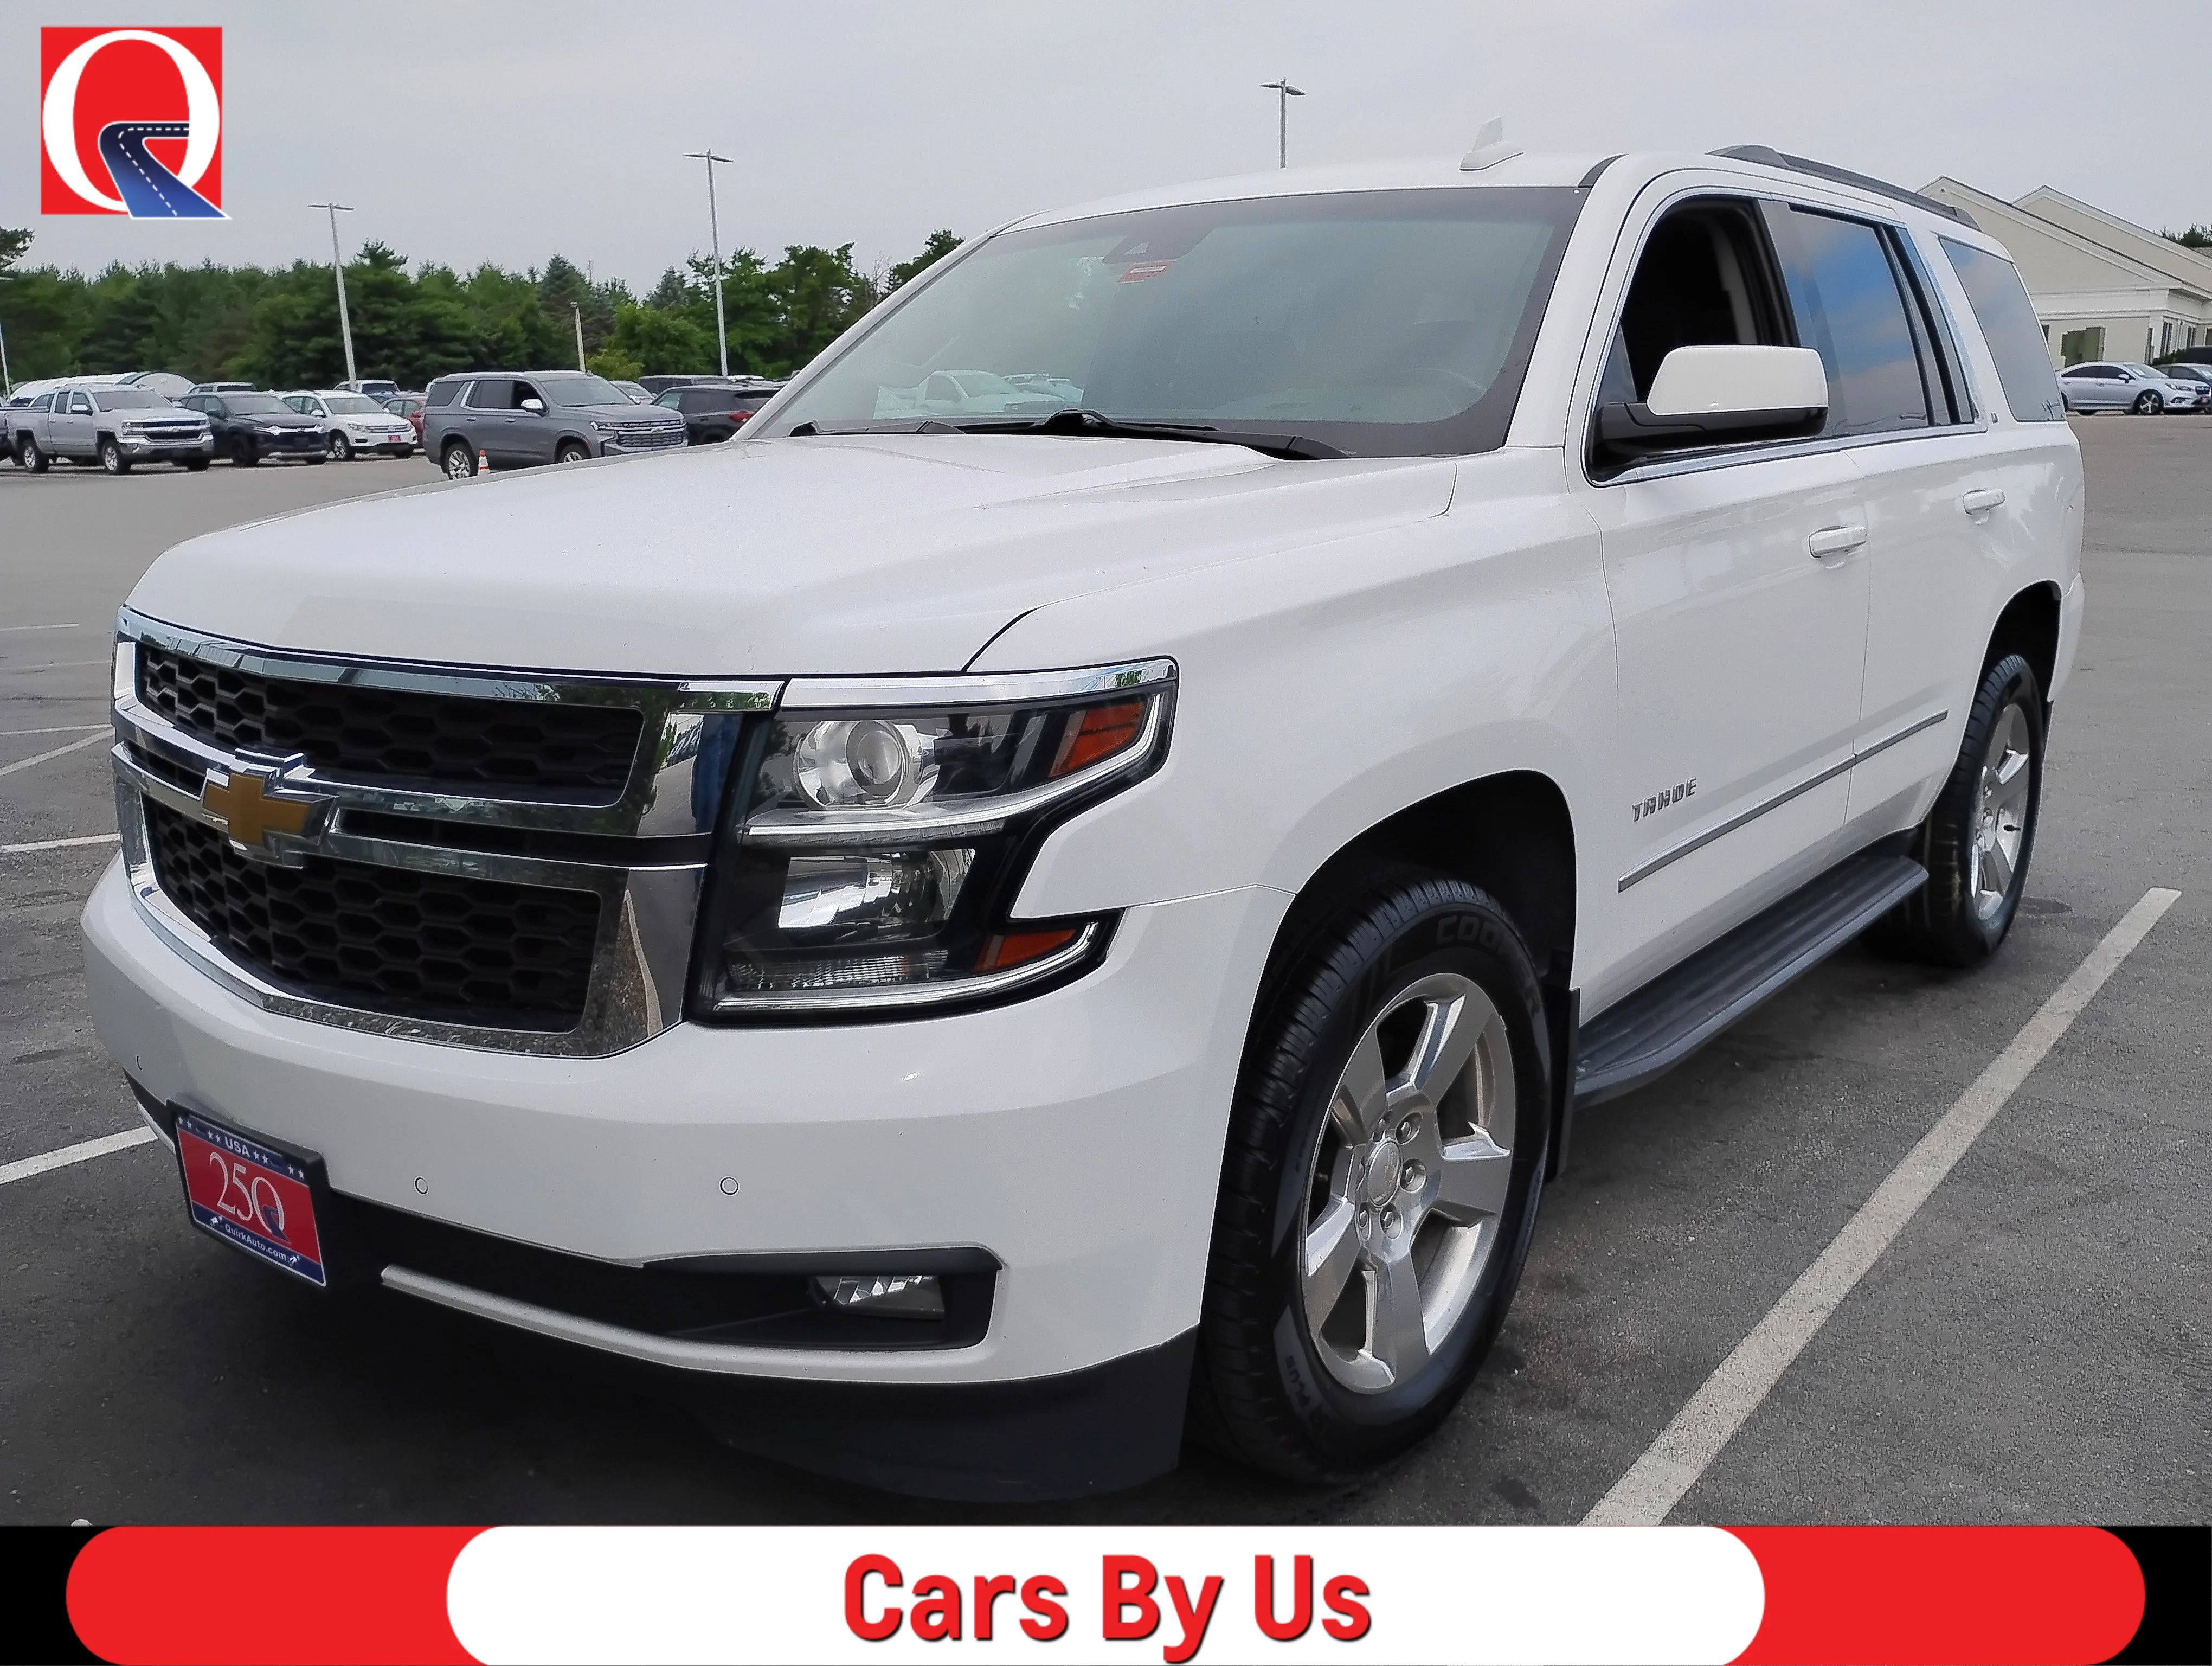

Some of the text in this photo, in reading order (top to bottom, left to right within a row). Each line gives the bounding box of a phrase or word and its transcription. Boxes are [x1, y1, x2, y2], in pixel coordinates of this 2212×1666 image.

[1632, 777, 1697, 823] TAHOE
[224, 1136, 250, 1157] USA
[225, 1223, 287, 1261] QuirkAuto.com
